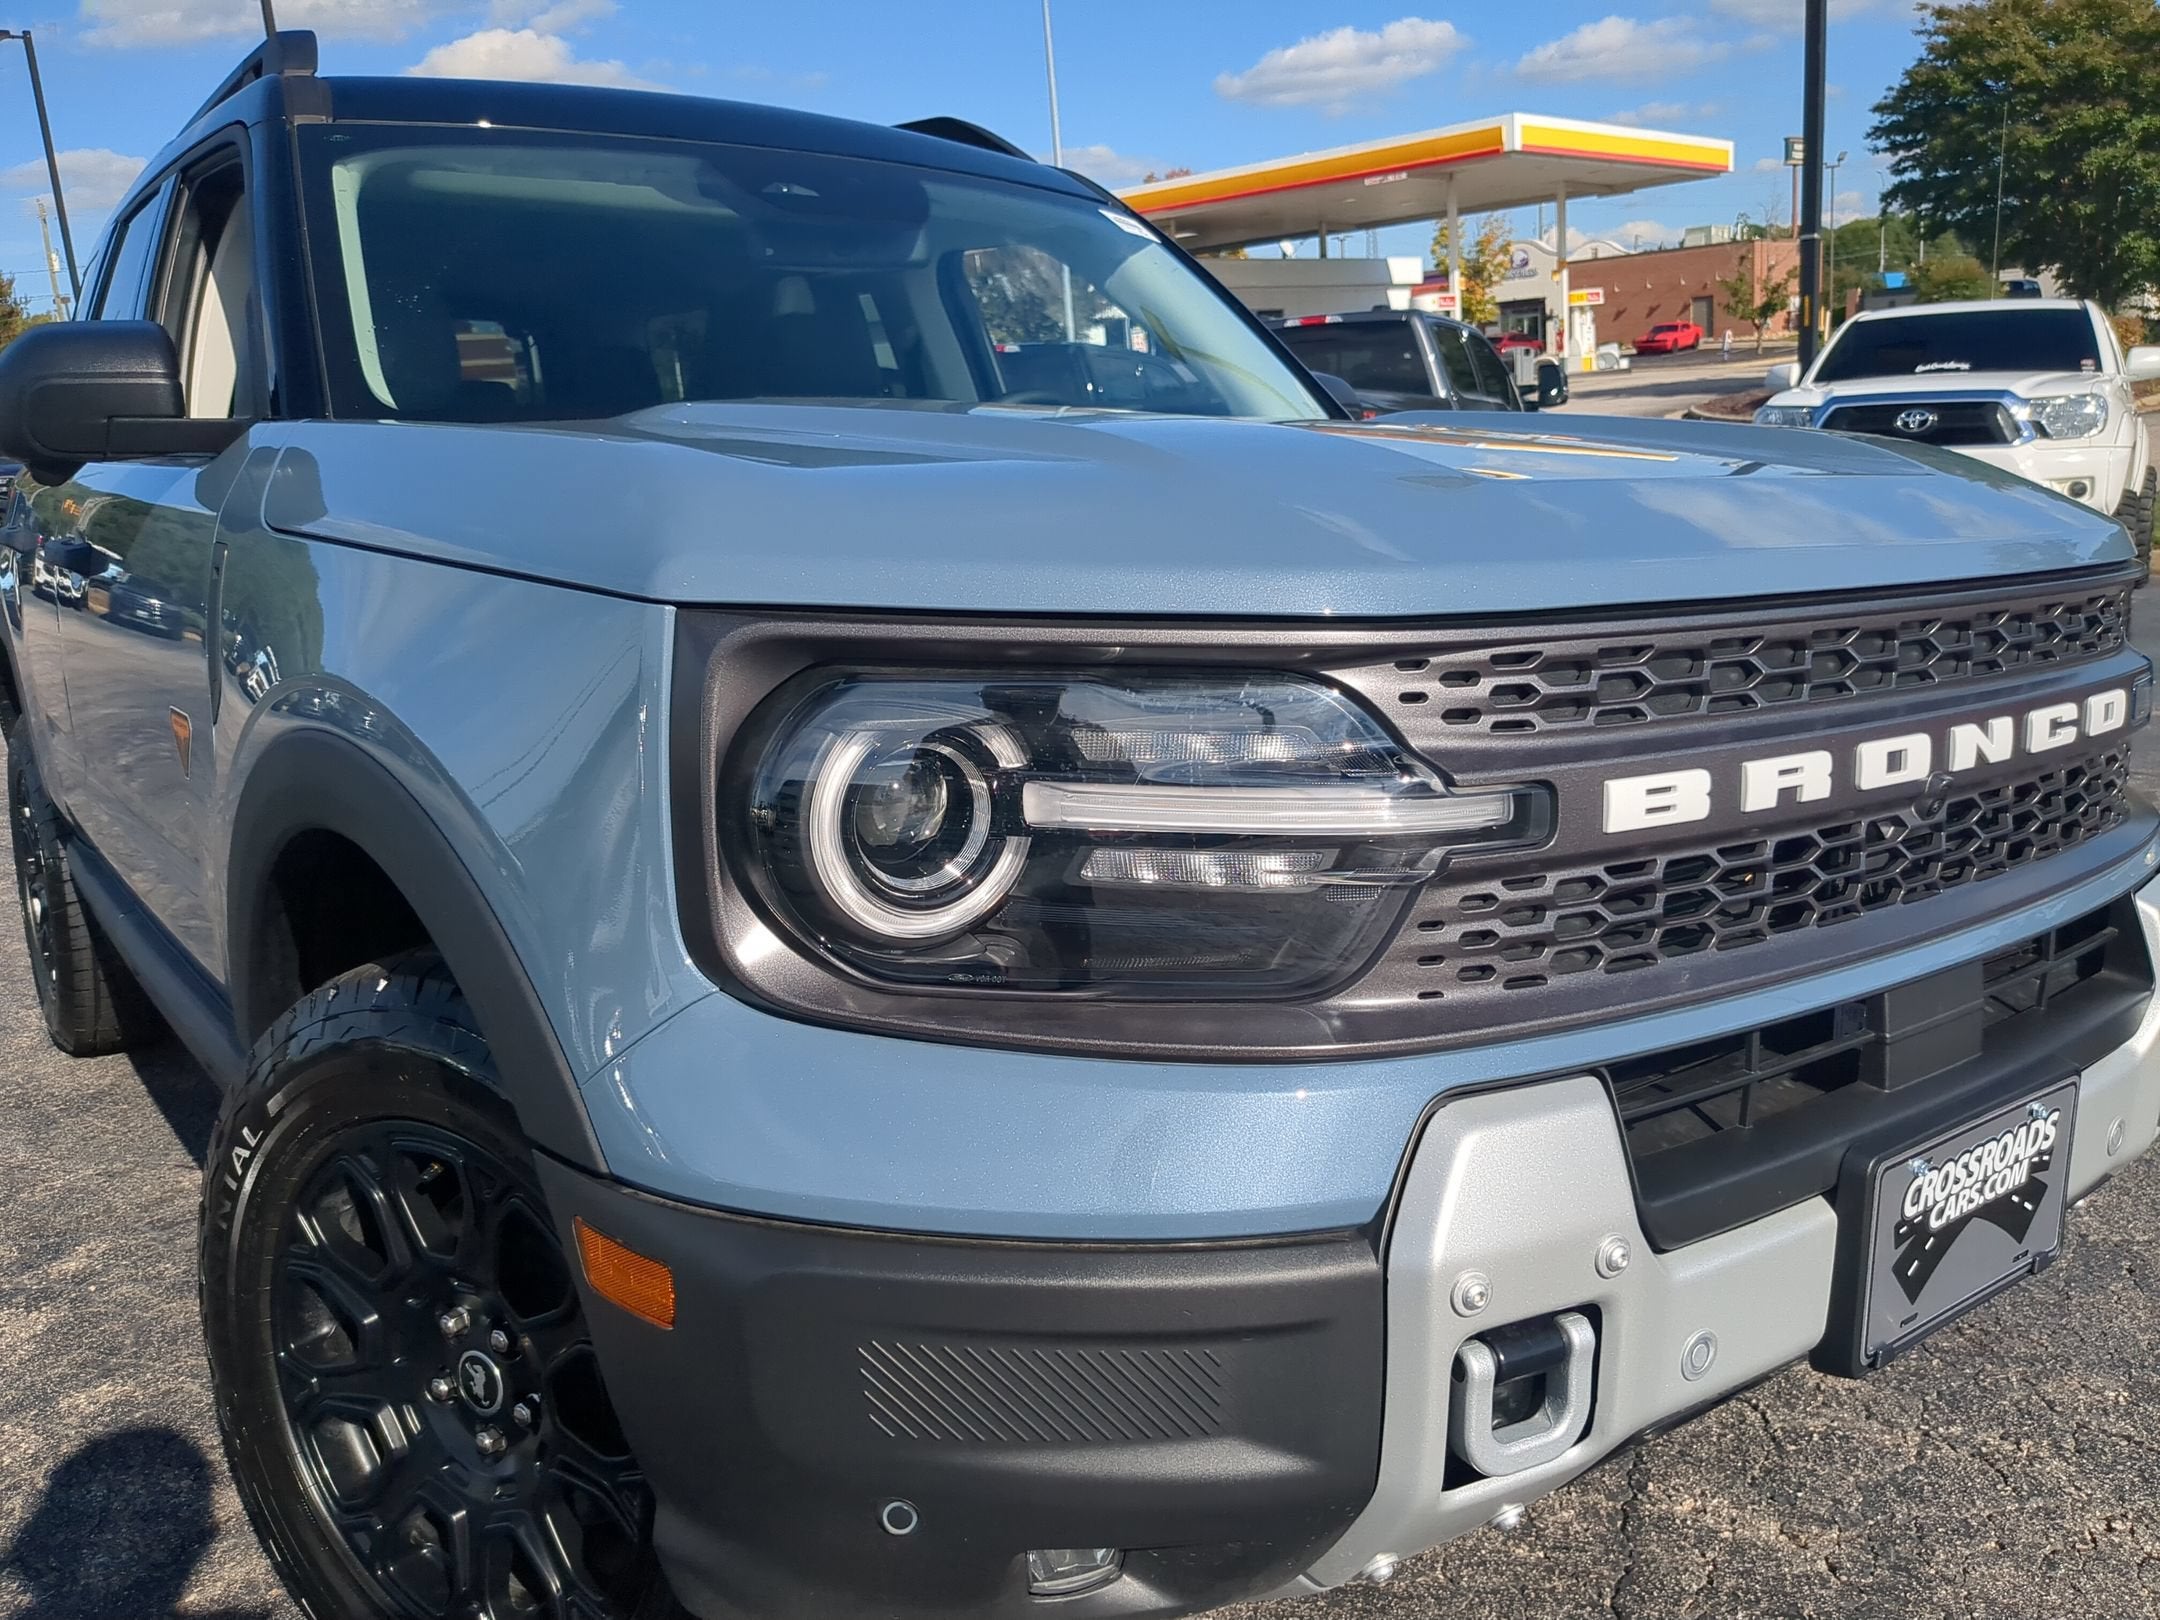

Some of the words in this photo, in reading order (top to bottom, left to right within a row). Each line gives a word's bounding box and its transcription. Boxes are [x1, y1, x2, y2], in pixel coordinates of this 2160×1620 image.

[1602, 688, 2126, 834] BRONCO
[1902, 1110, 2060, 1219] CROSSROADS
[1930, 1157, 2029, 1230] CARS.COM
